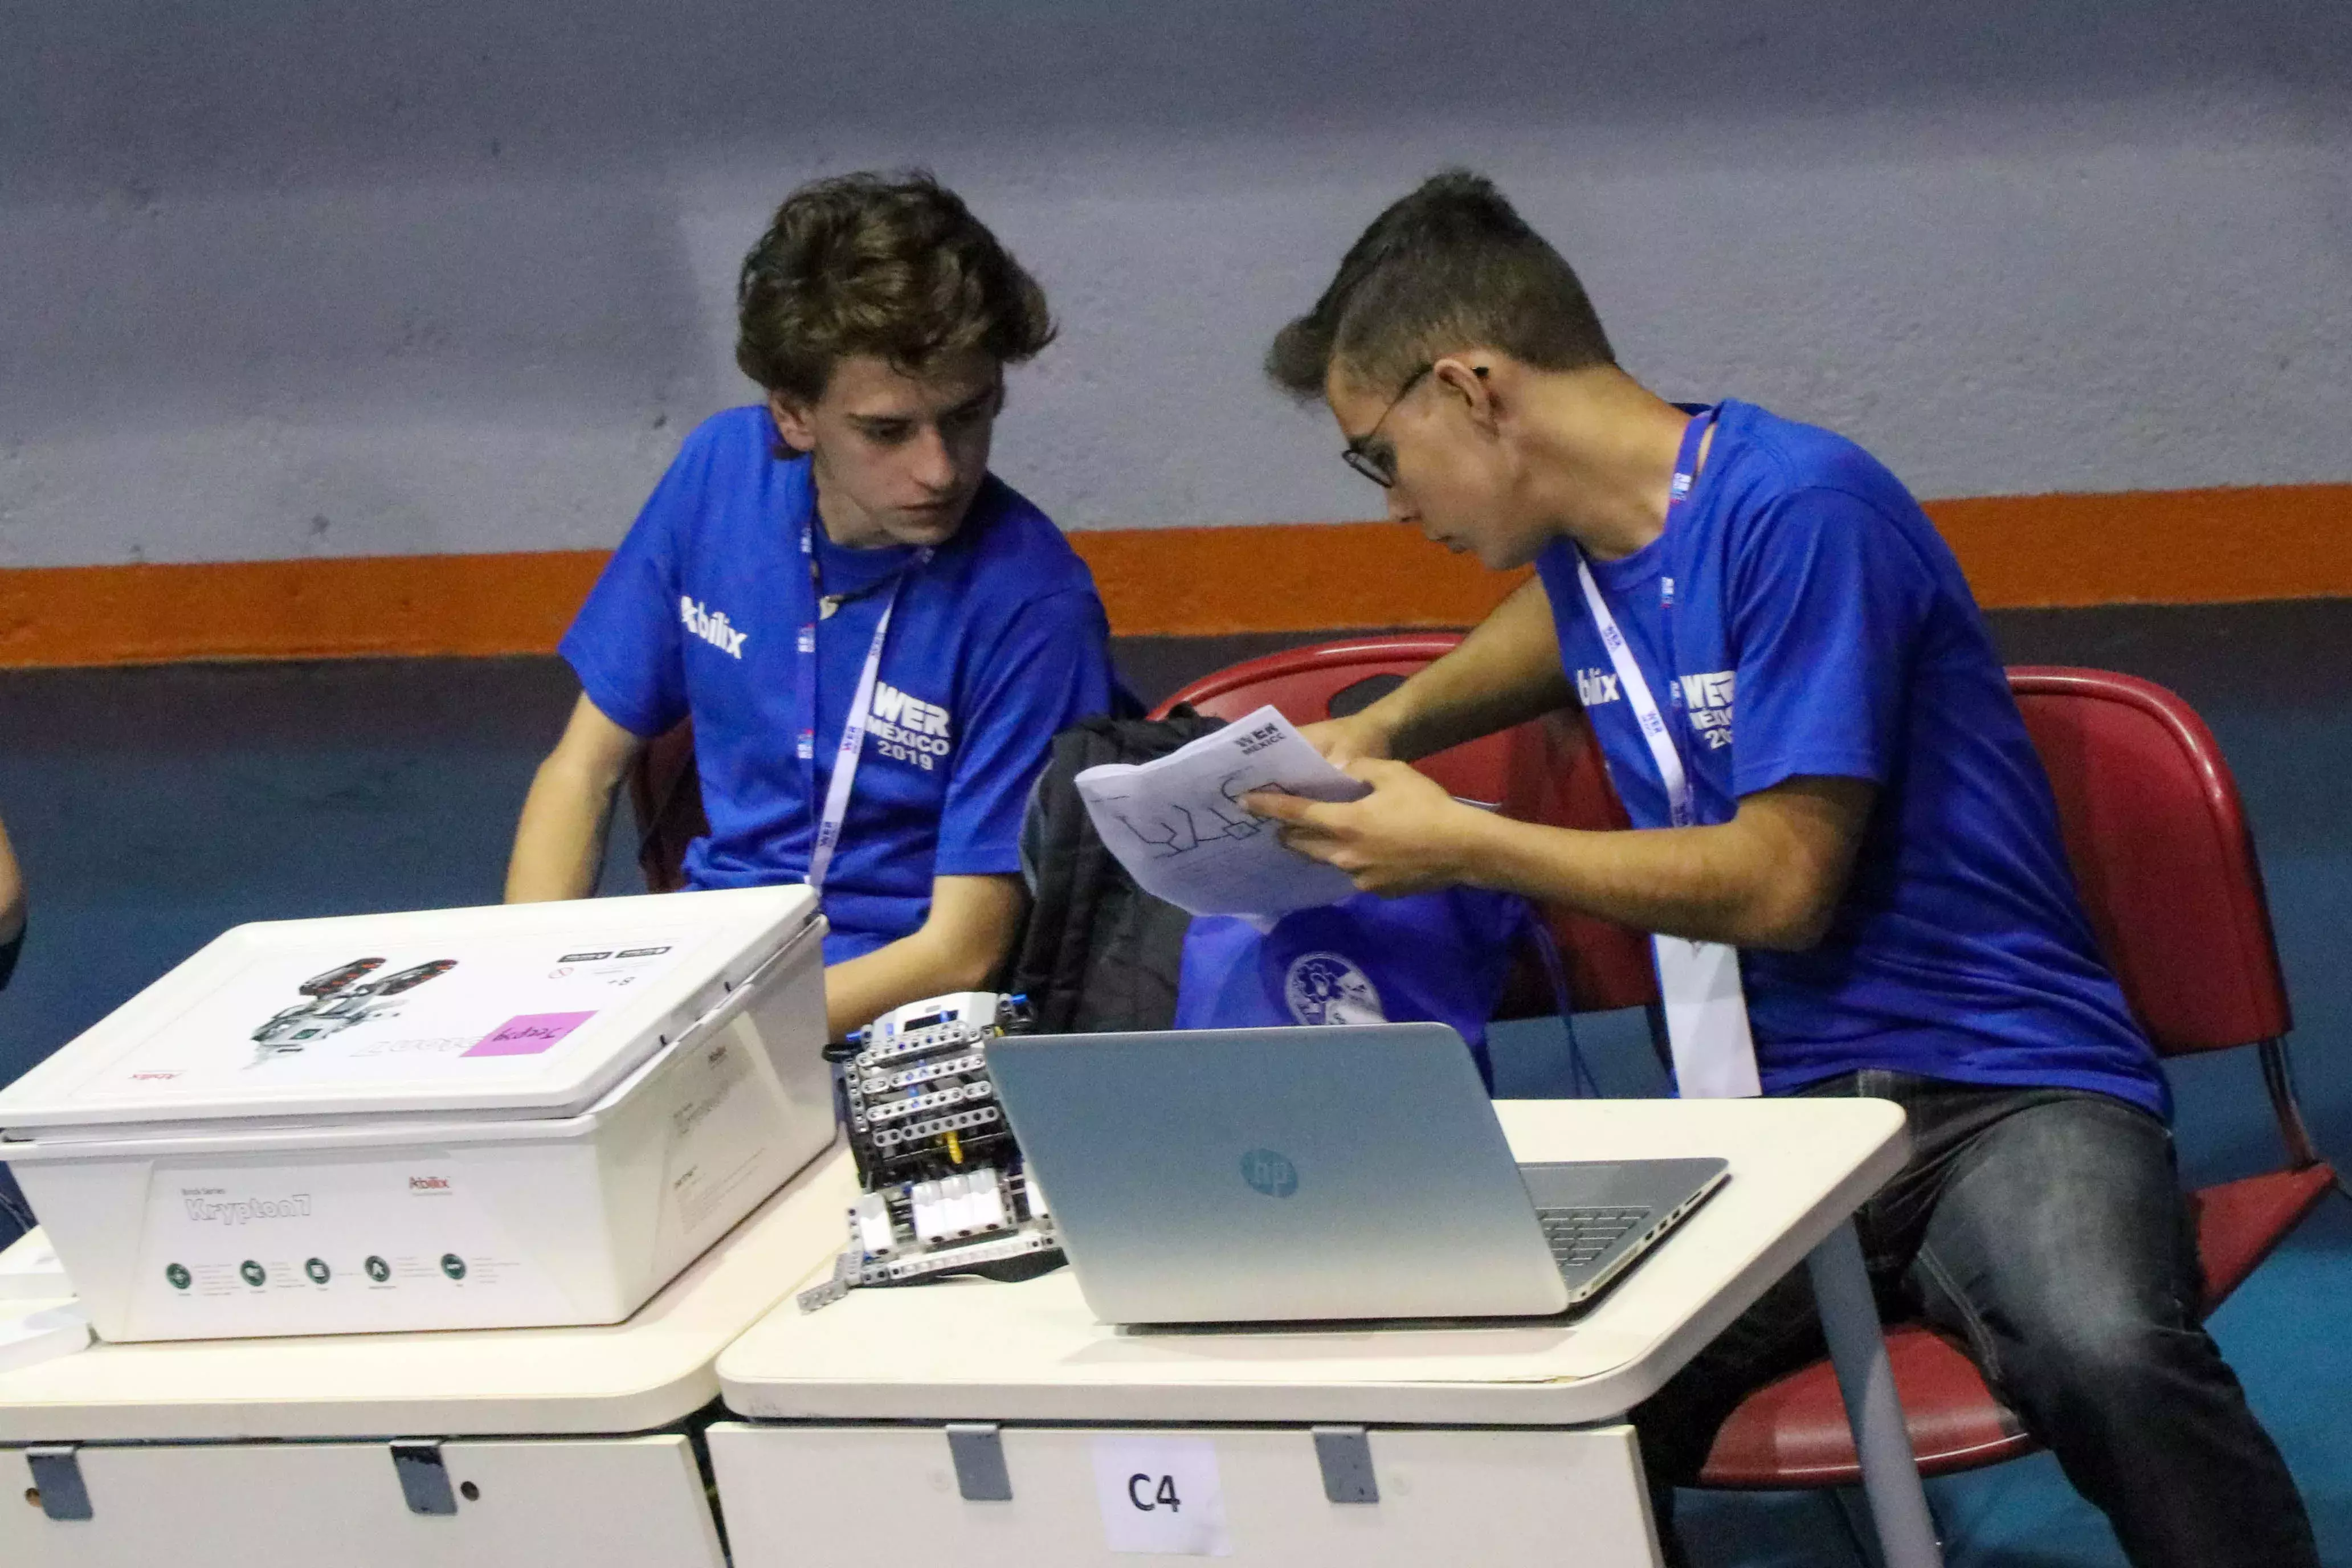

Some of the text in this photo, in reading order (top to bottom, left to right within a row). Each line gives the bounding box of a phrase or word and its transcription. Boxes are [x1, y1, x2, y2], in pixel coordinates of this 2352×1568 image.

[873, 680, 951, 738] WER
[877, 740, 934, 771] 2019
[183, 1194, 311, 1226] Krypton7
[1128, 1472, 1182, 1513] C4
